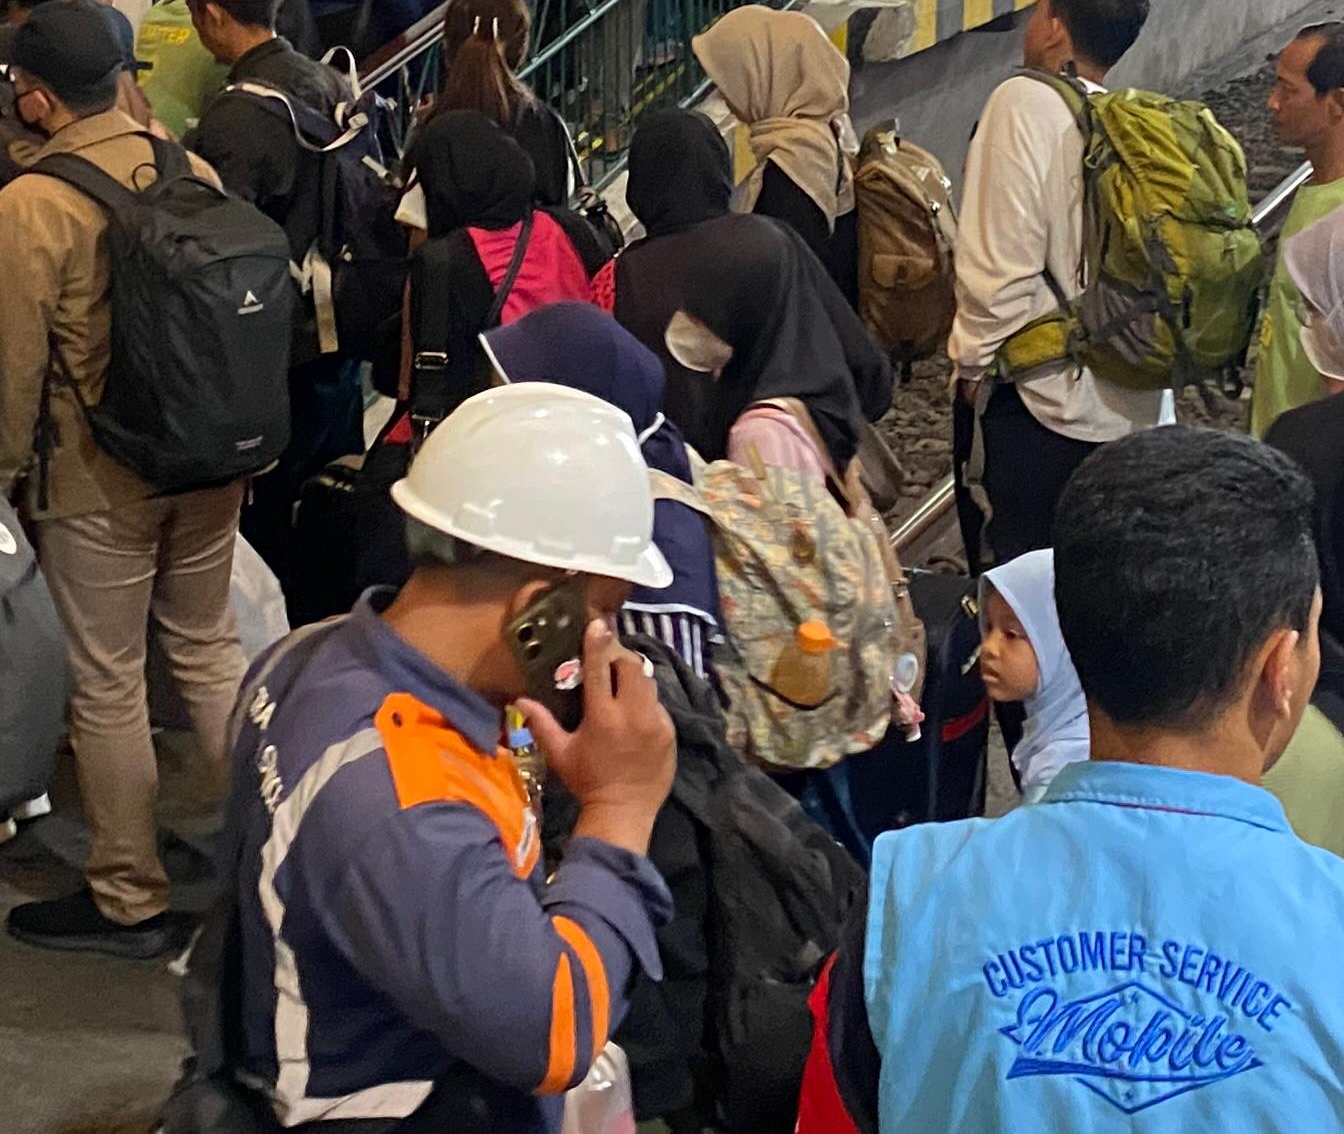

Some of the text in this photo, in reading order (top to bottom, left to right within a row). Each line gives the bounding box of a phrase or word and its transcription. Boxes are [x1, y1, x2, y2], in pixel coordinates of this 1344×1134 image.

[982, 931, 1292, 1032] CUSTOMER SERVICE
[1016, 987, 1256, 1070] Mobile
